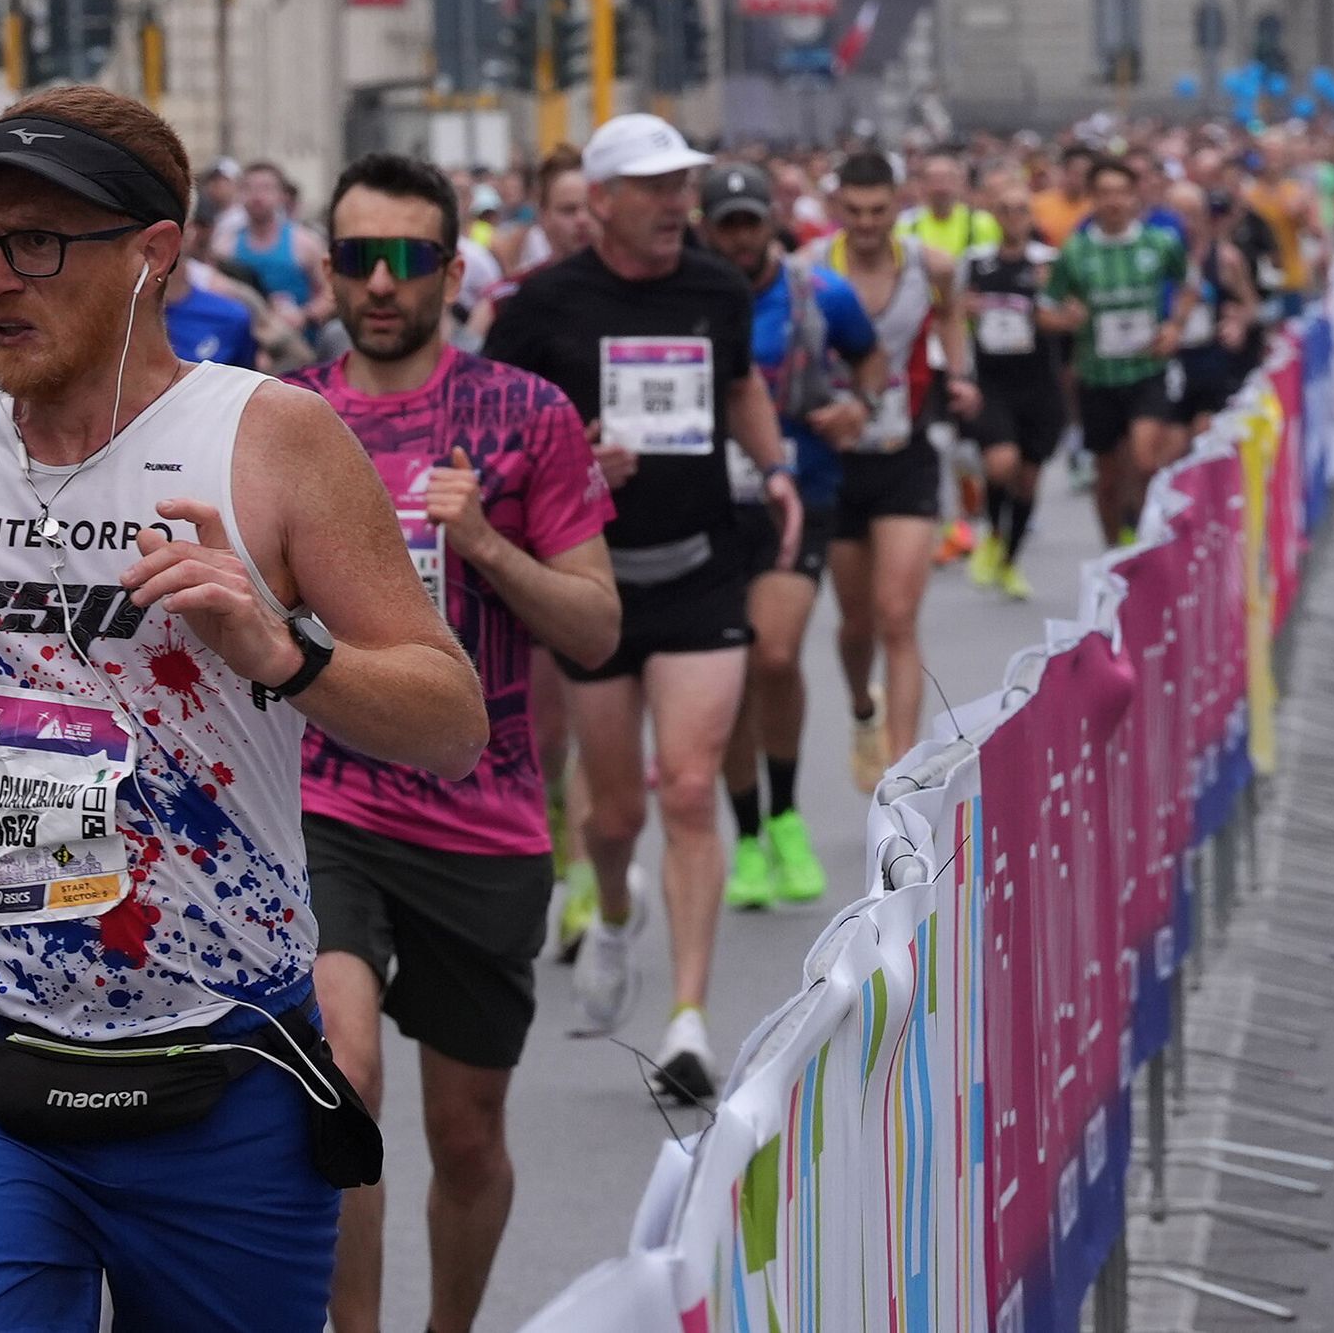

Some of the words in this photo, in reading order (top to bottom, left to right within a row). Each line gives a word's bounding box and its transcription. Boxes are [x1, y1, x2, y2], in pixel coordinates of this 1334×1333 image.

[61, 882, 90, 893] START
[4, 891, 31, 904] asics
[47, 1089, 148, 1108] macron
